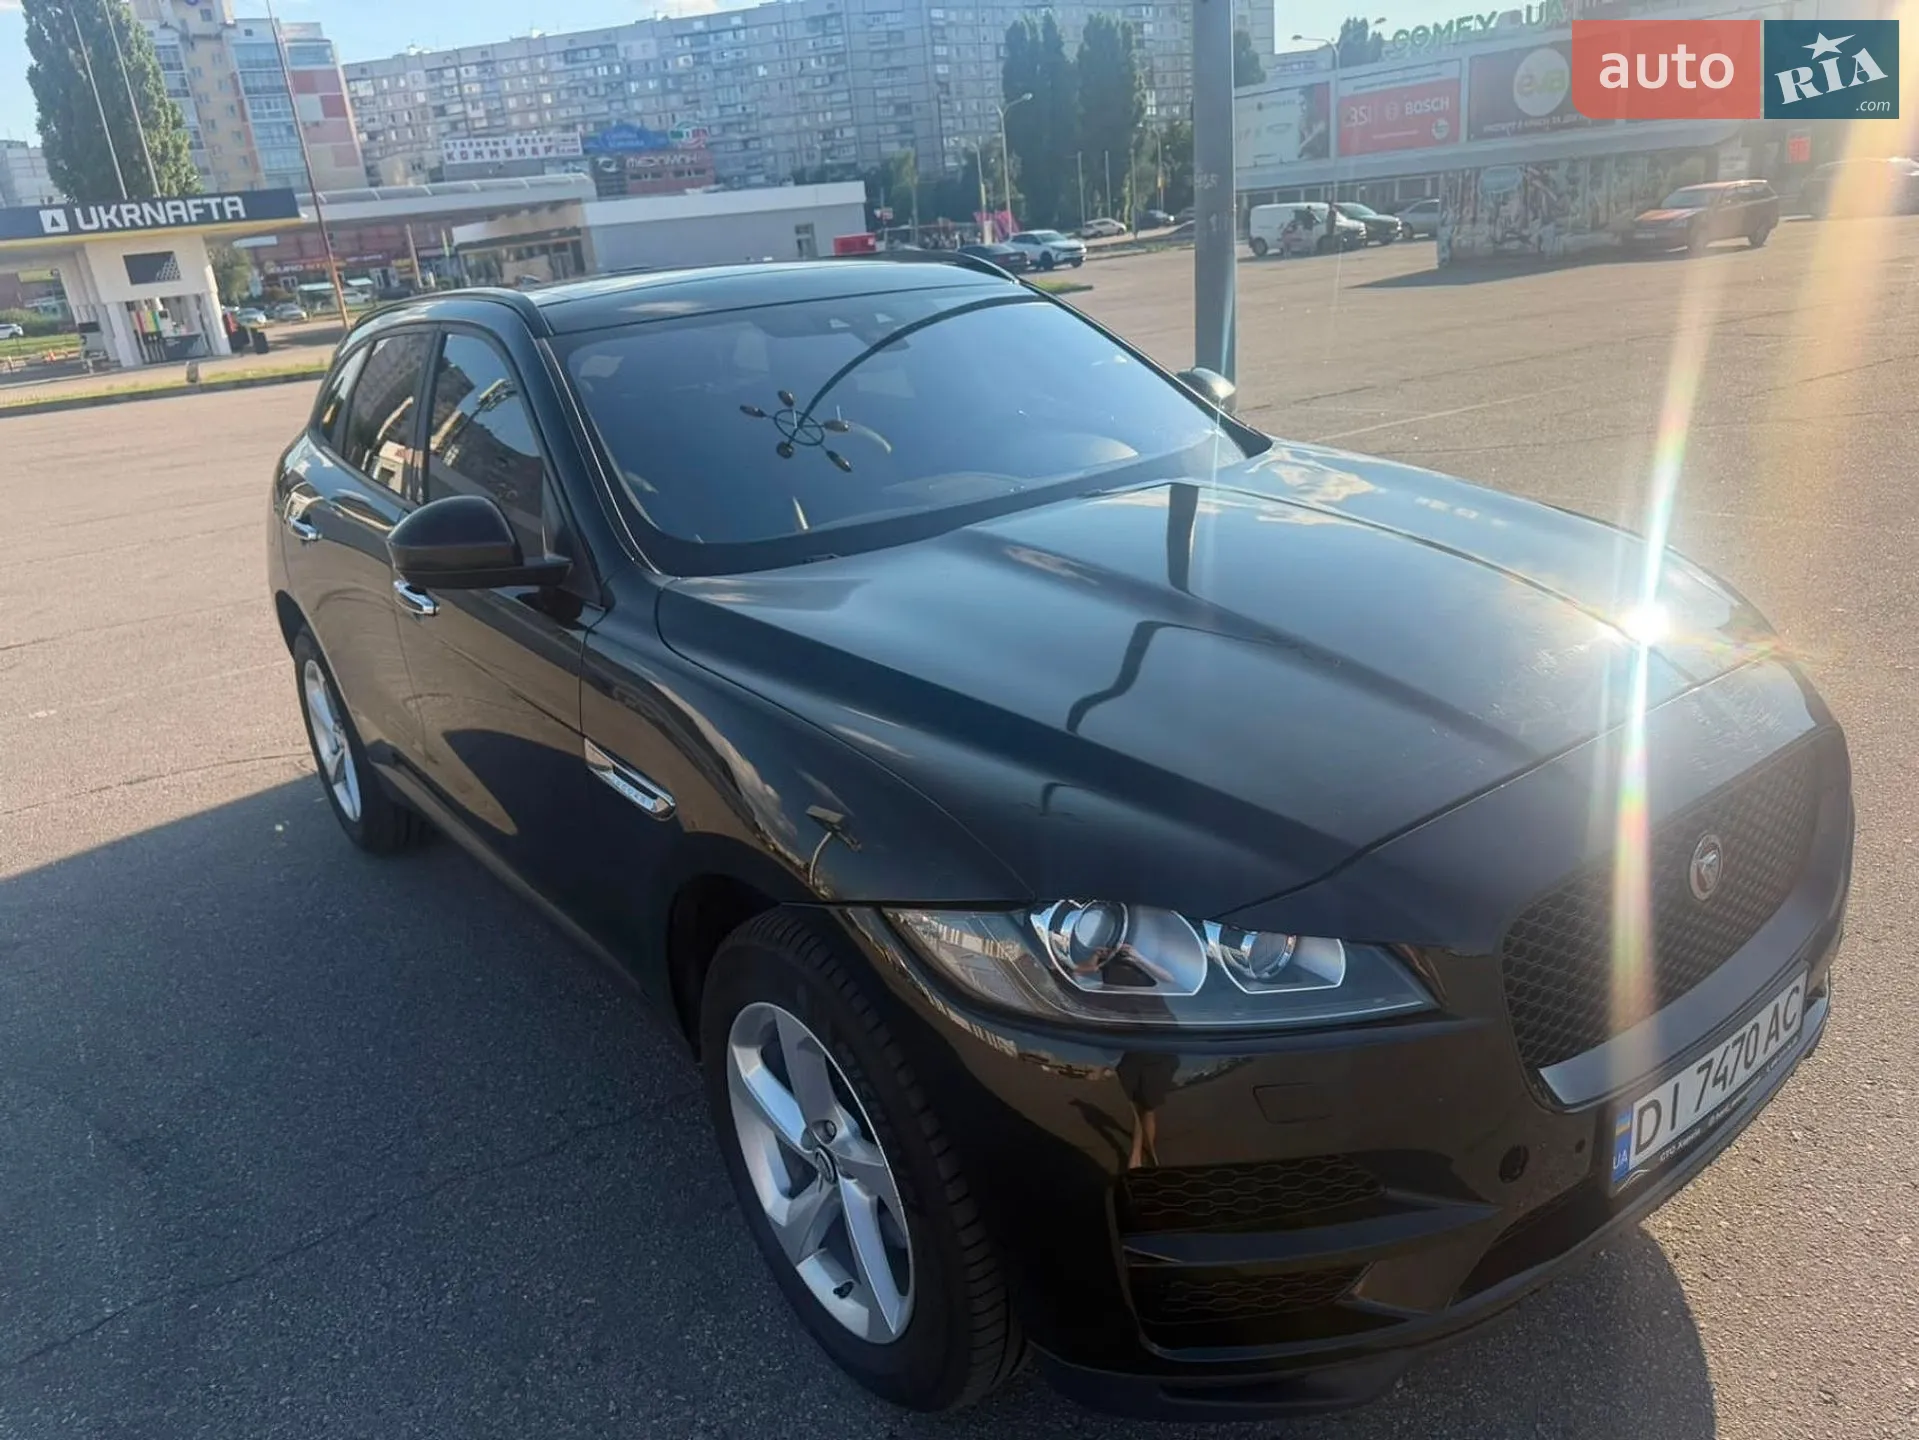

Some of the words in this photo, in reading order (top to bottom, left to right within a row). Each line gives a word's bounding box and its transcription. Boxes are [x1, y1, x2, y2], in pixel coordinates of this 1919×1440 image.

[1393, 11, 1498, 50] COMFY
[1405, 97, 1449, 116] BOSCH
[445, 144, 554, 161] КОММУНАР
[75, 196, 247, 231] UKRNAFTA
[1635, 1082, 1680, 1156] DI
[1695, 1021, 1760, 1114] 7470
[1763, 985, 1801, 1055] AC
[1612, 1148, 1629, 1171] UA
